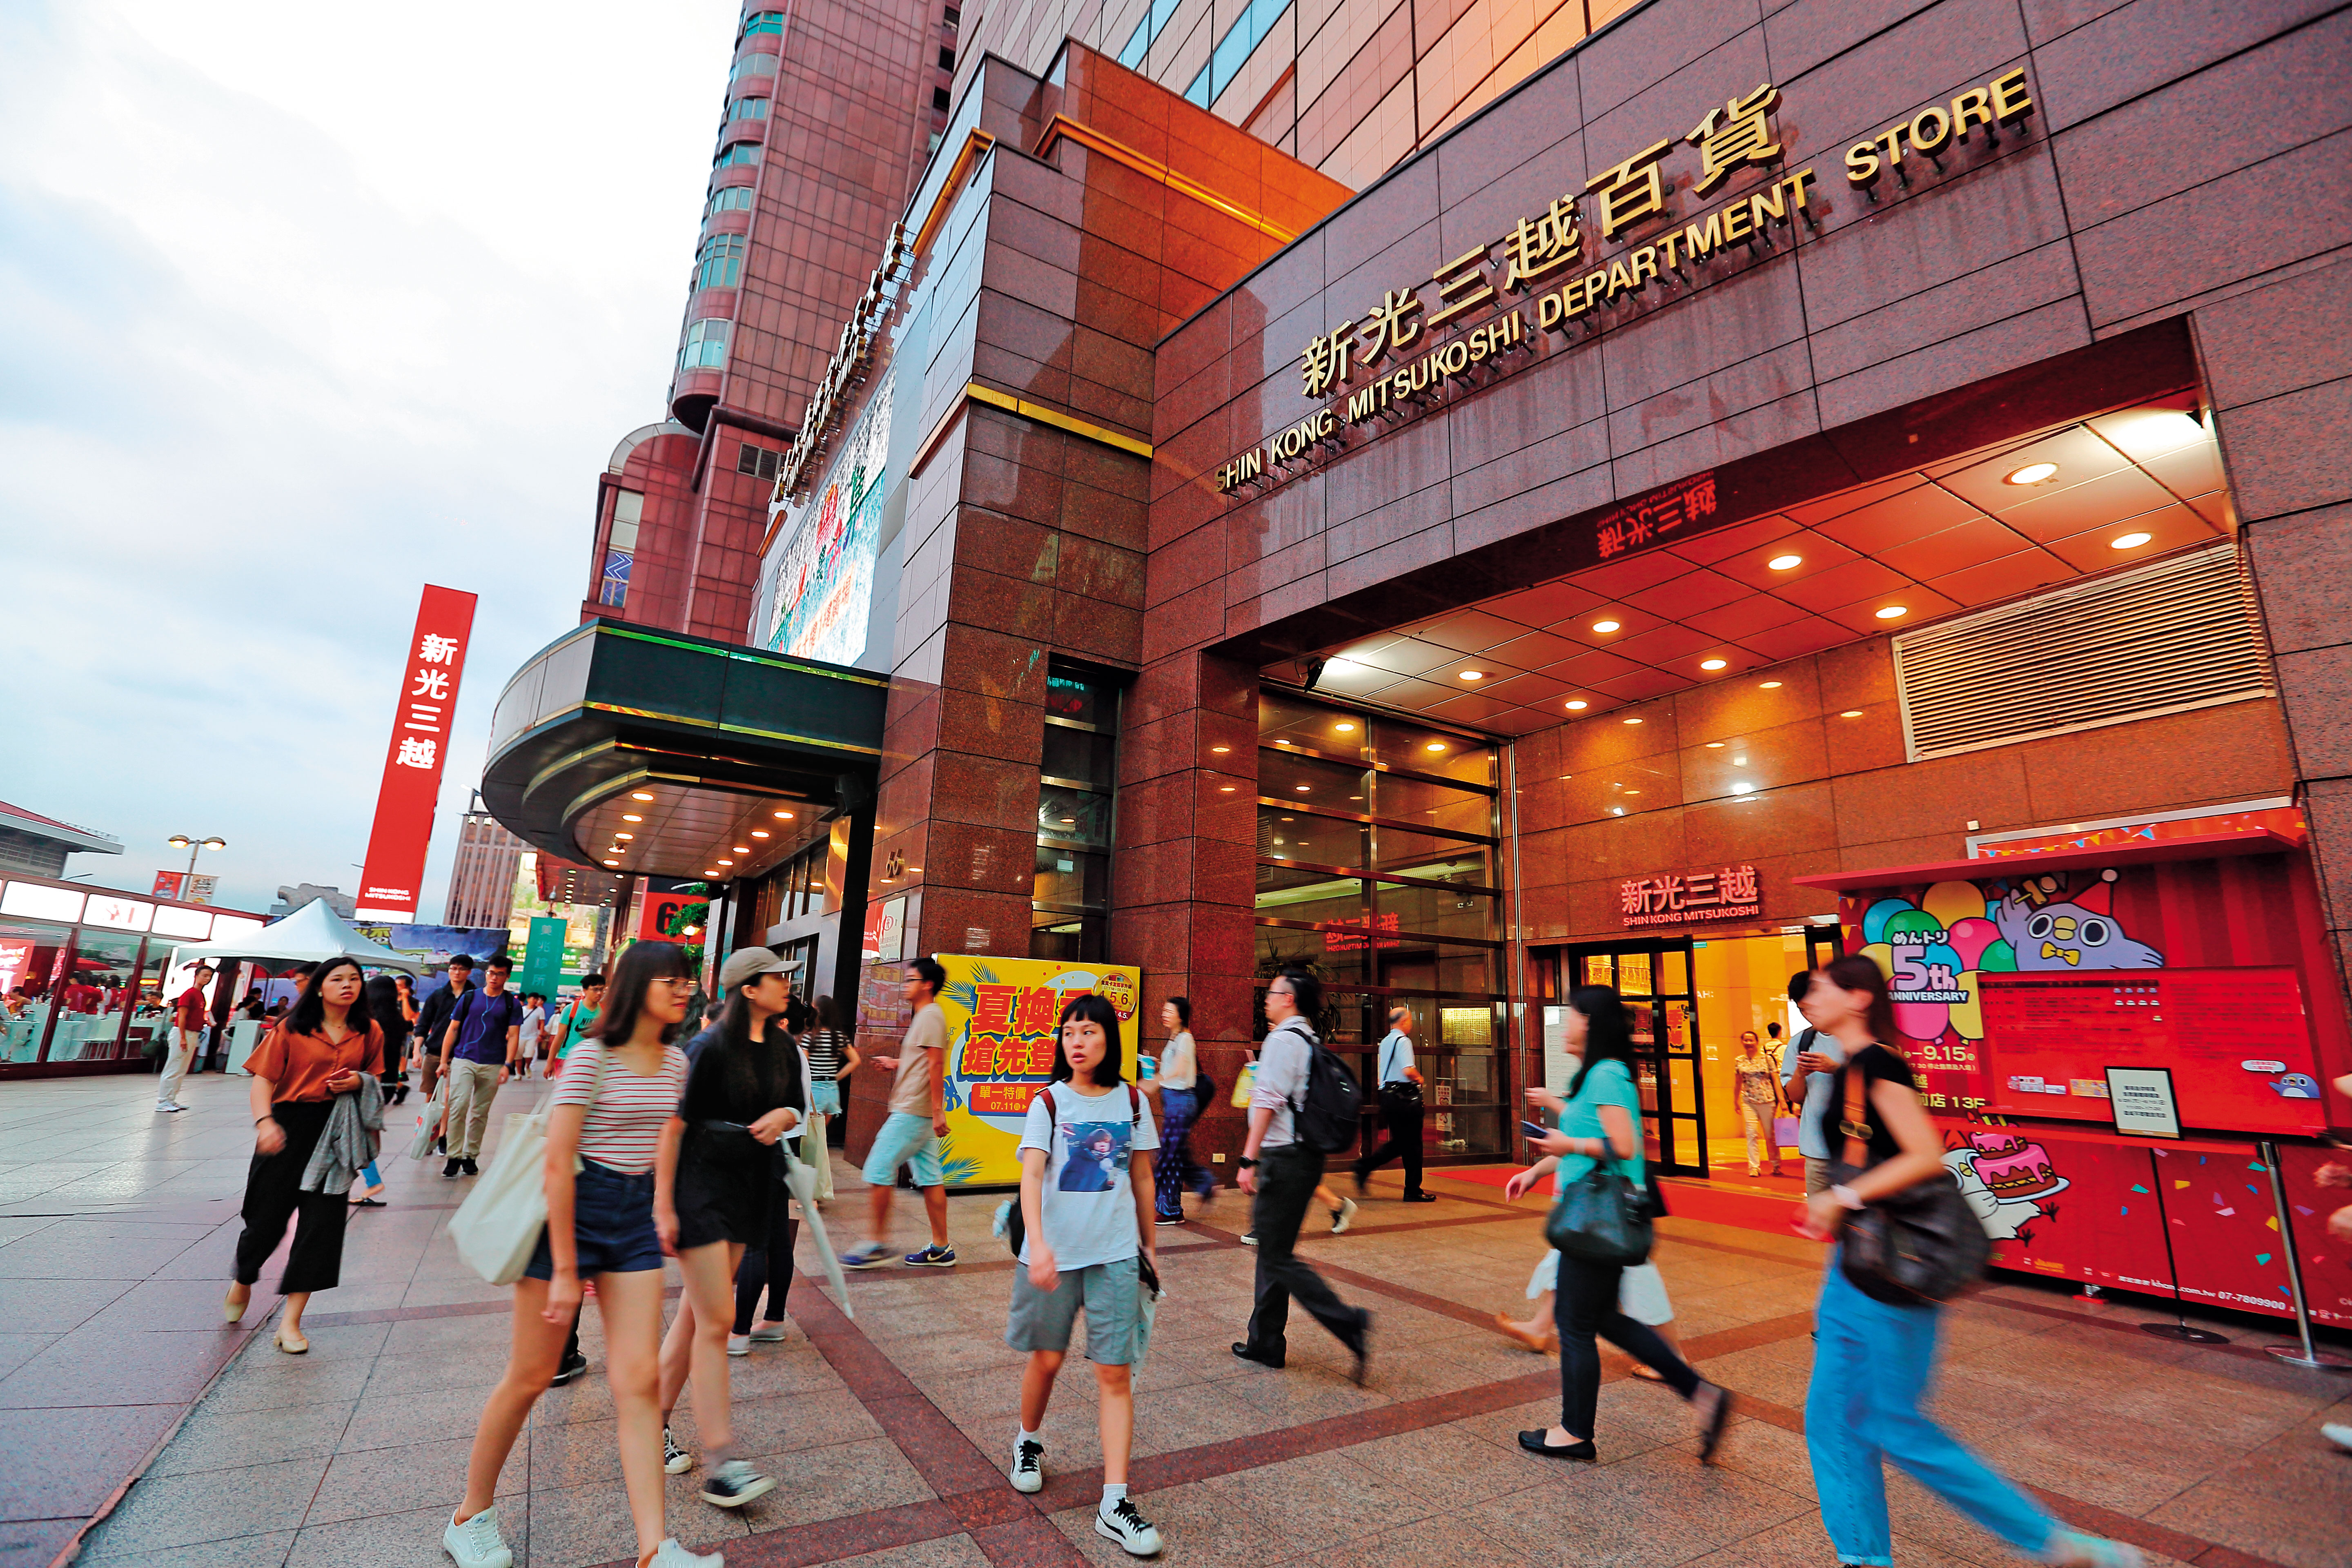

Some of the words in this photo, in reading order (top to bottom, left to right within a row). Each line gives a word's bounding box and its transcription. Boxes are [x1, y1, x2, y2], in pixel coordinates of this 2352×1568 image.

[1301, 83, 1784, 396] 新光三越百貨
[1214, 448, 1261, 492] SHIN
[1271, 408, 1333, 464] KONG
[1348, 310, 1519, 423] MITSUKOSHI
[1539, 167, 1814, 329] DEPARTMENT
[1844, 67, 2032, 183] STORE
[395, 633, 458, 769] 新光三越
[365, 892, 411, 902] MITSUKOSHI
[1621, 865, 1758, 914] 新光三越
[1623, 916, 1649, 926] SHIN
[1650, 912, 1682, 924] KONG
[1684, 905, 1759, 921] MITSUKOSHI
[1892, 931, 1948, 945] めんトリ
[1893, 945, 1957, 991] 5th
[1888, 991, 1968, 1001] ANNIVERSARY
[979, 1086, 1026, 1100] 單一特價
[1952, 1096, 1986, 1109] 13F
